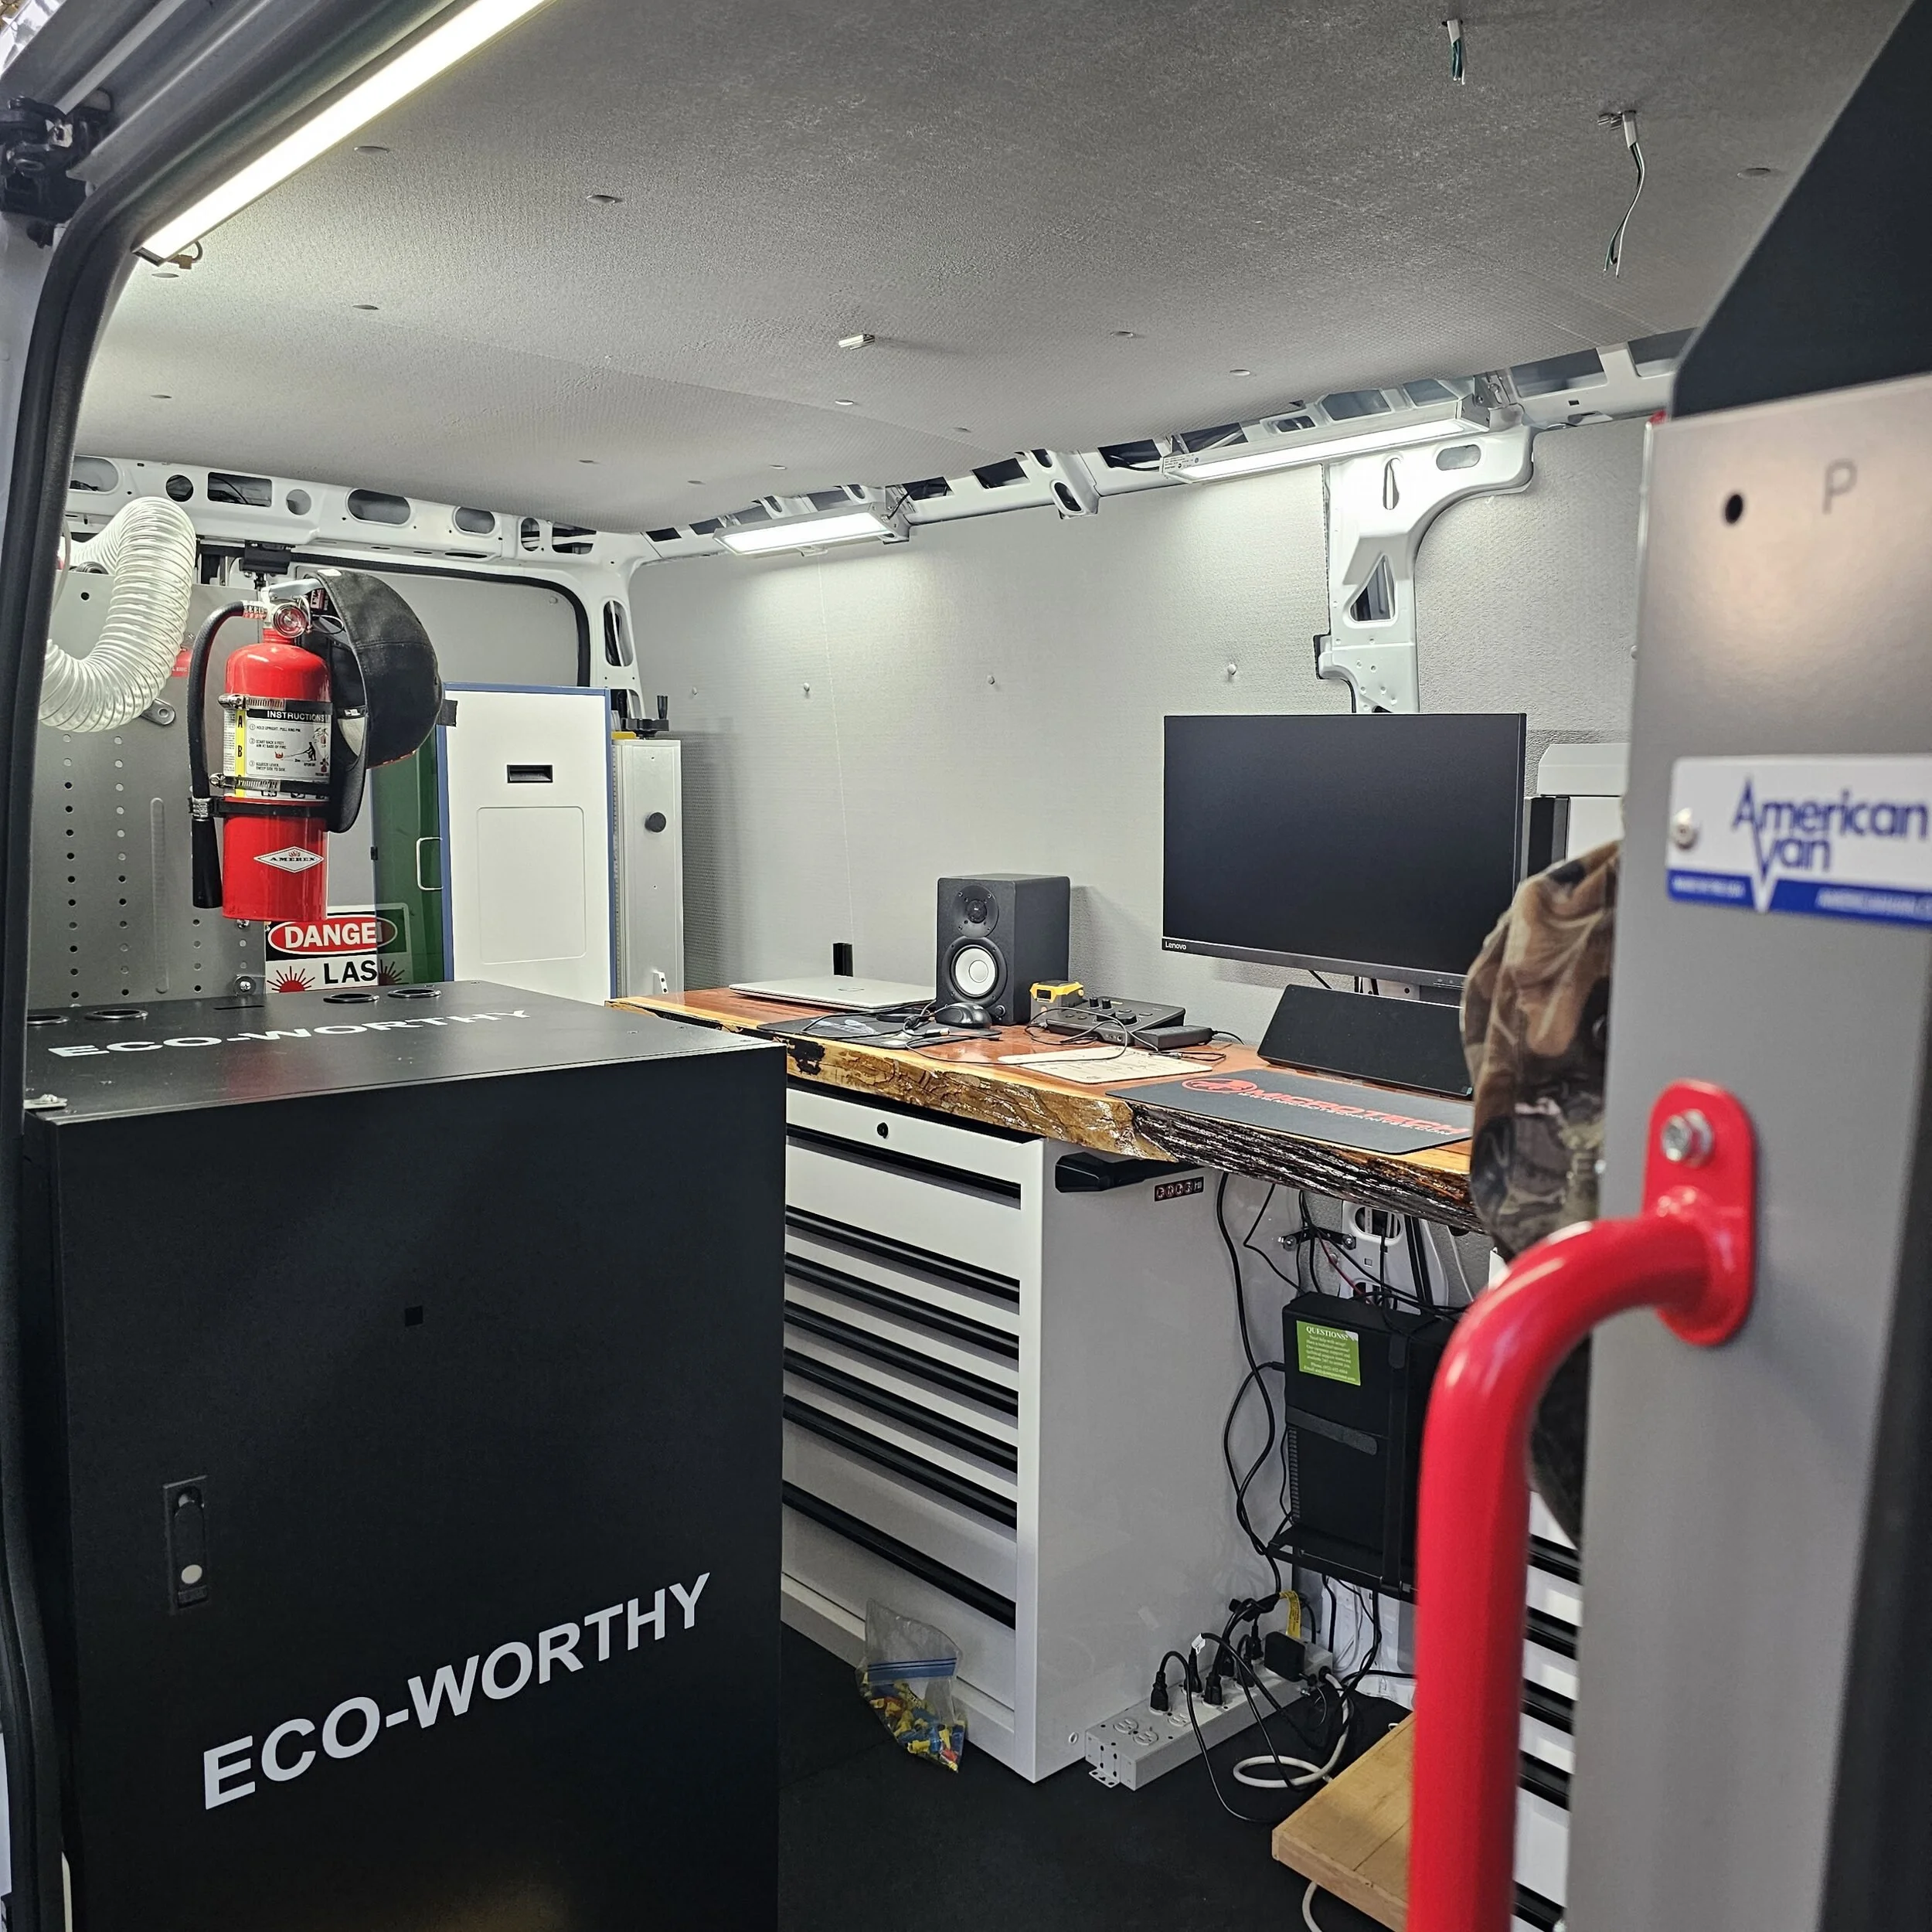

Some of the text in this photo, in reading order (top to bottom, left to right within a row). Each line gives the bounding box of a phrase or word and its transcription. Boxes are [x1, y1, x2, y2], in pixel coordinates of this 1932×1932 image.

[237, 716, 243, 728] A
[267, 711, 325, 722] INSTRUCTIONS
[237, 745, 243, 757] B
[1732, 774, 1929, 841] American
[1750, 829, 1832, 883] Van
[284, 921, 383, 949] DANGE
[1165, 940, 1187, 950] Lenovo
[48, 1009, 530, 1057] ECO-WORTHY
[1245, 1090, 1471, 1134] MICROTECH
[1306, 1326, 1348, 1341] QUESTIONS?
[204, 1572, 710, 1810] ECO-WORTHY
